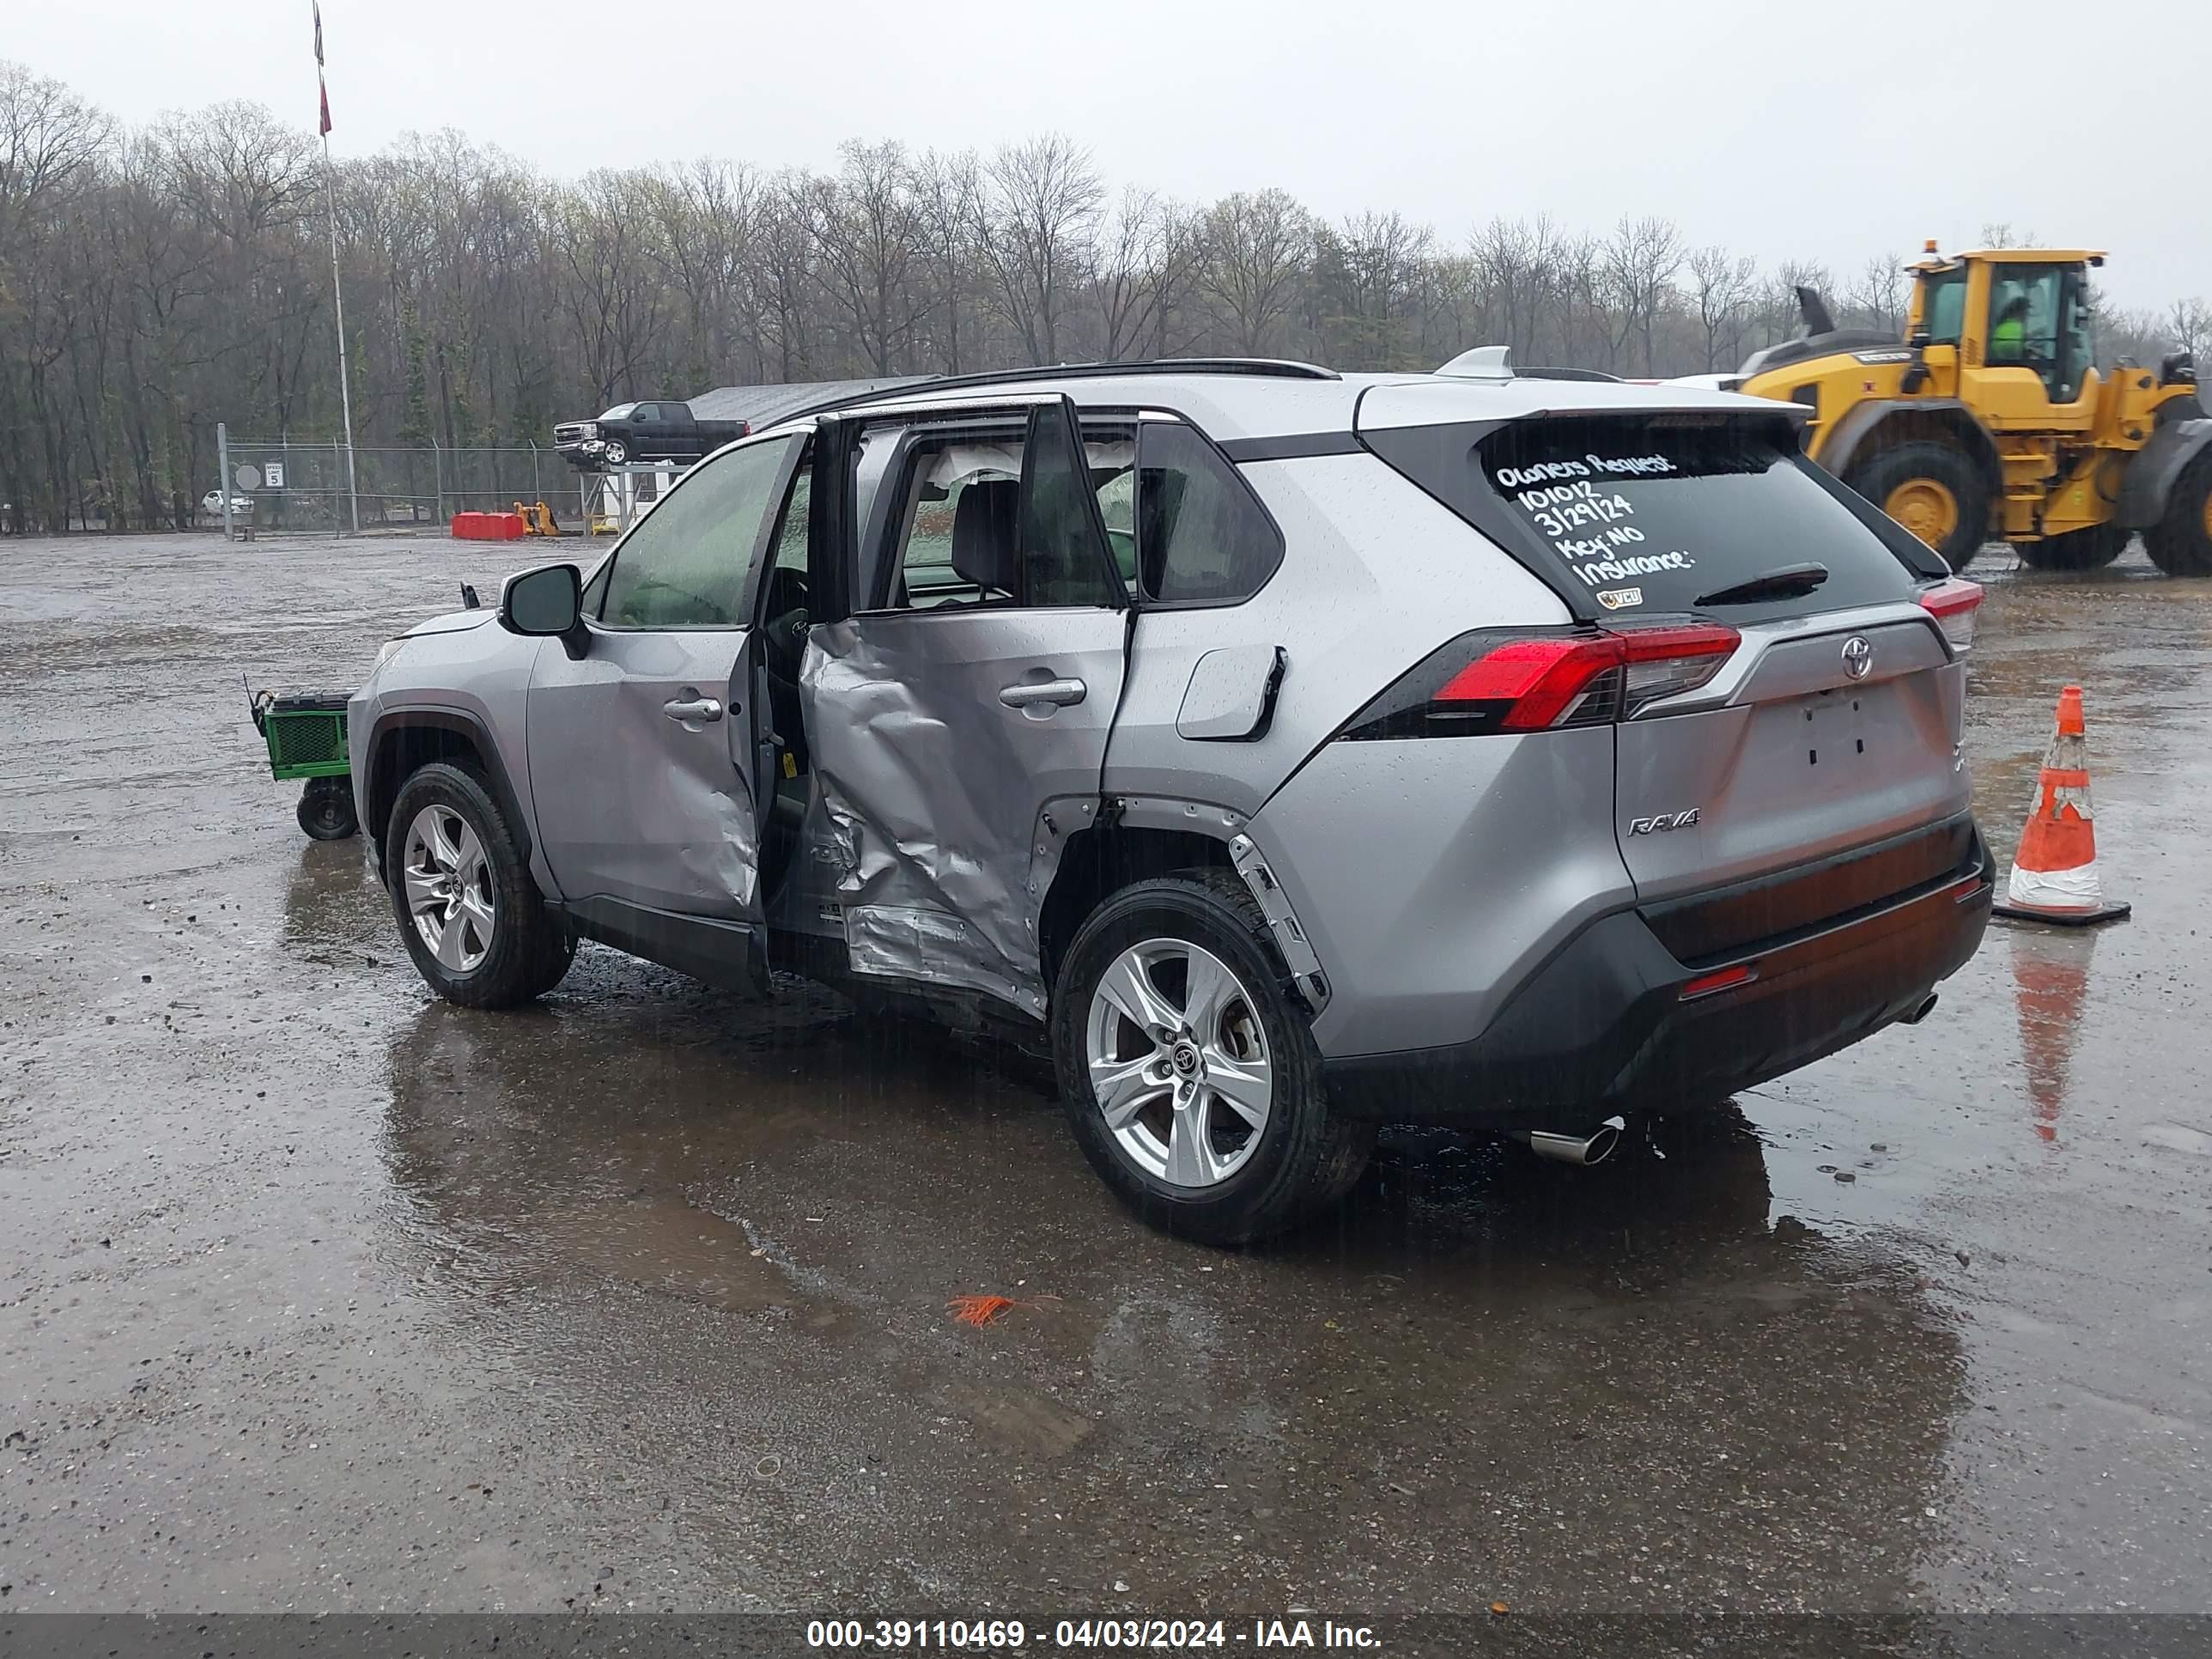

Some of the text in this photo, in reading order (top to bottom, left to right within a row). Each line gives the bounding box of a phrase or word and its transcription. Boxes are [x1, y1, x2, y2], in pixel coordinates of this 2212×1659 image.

[270, 475, 278, 484] 5
[1497, 453, 1678, 488] Owners Request
[1517, 480, 1602, 512] 101012
[1534, 494, 1634, 537] 3/29/24
[1572, 550, 1697, 586] Insurance:
[1613, 589, 1639, 605] VCU
[1627, 807, 1701, 837] RAV4
